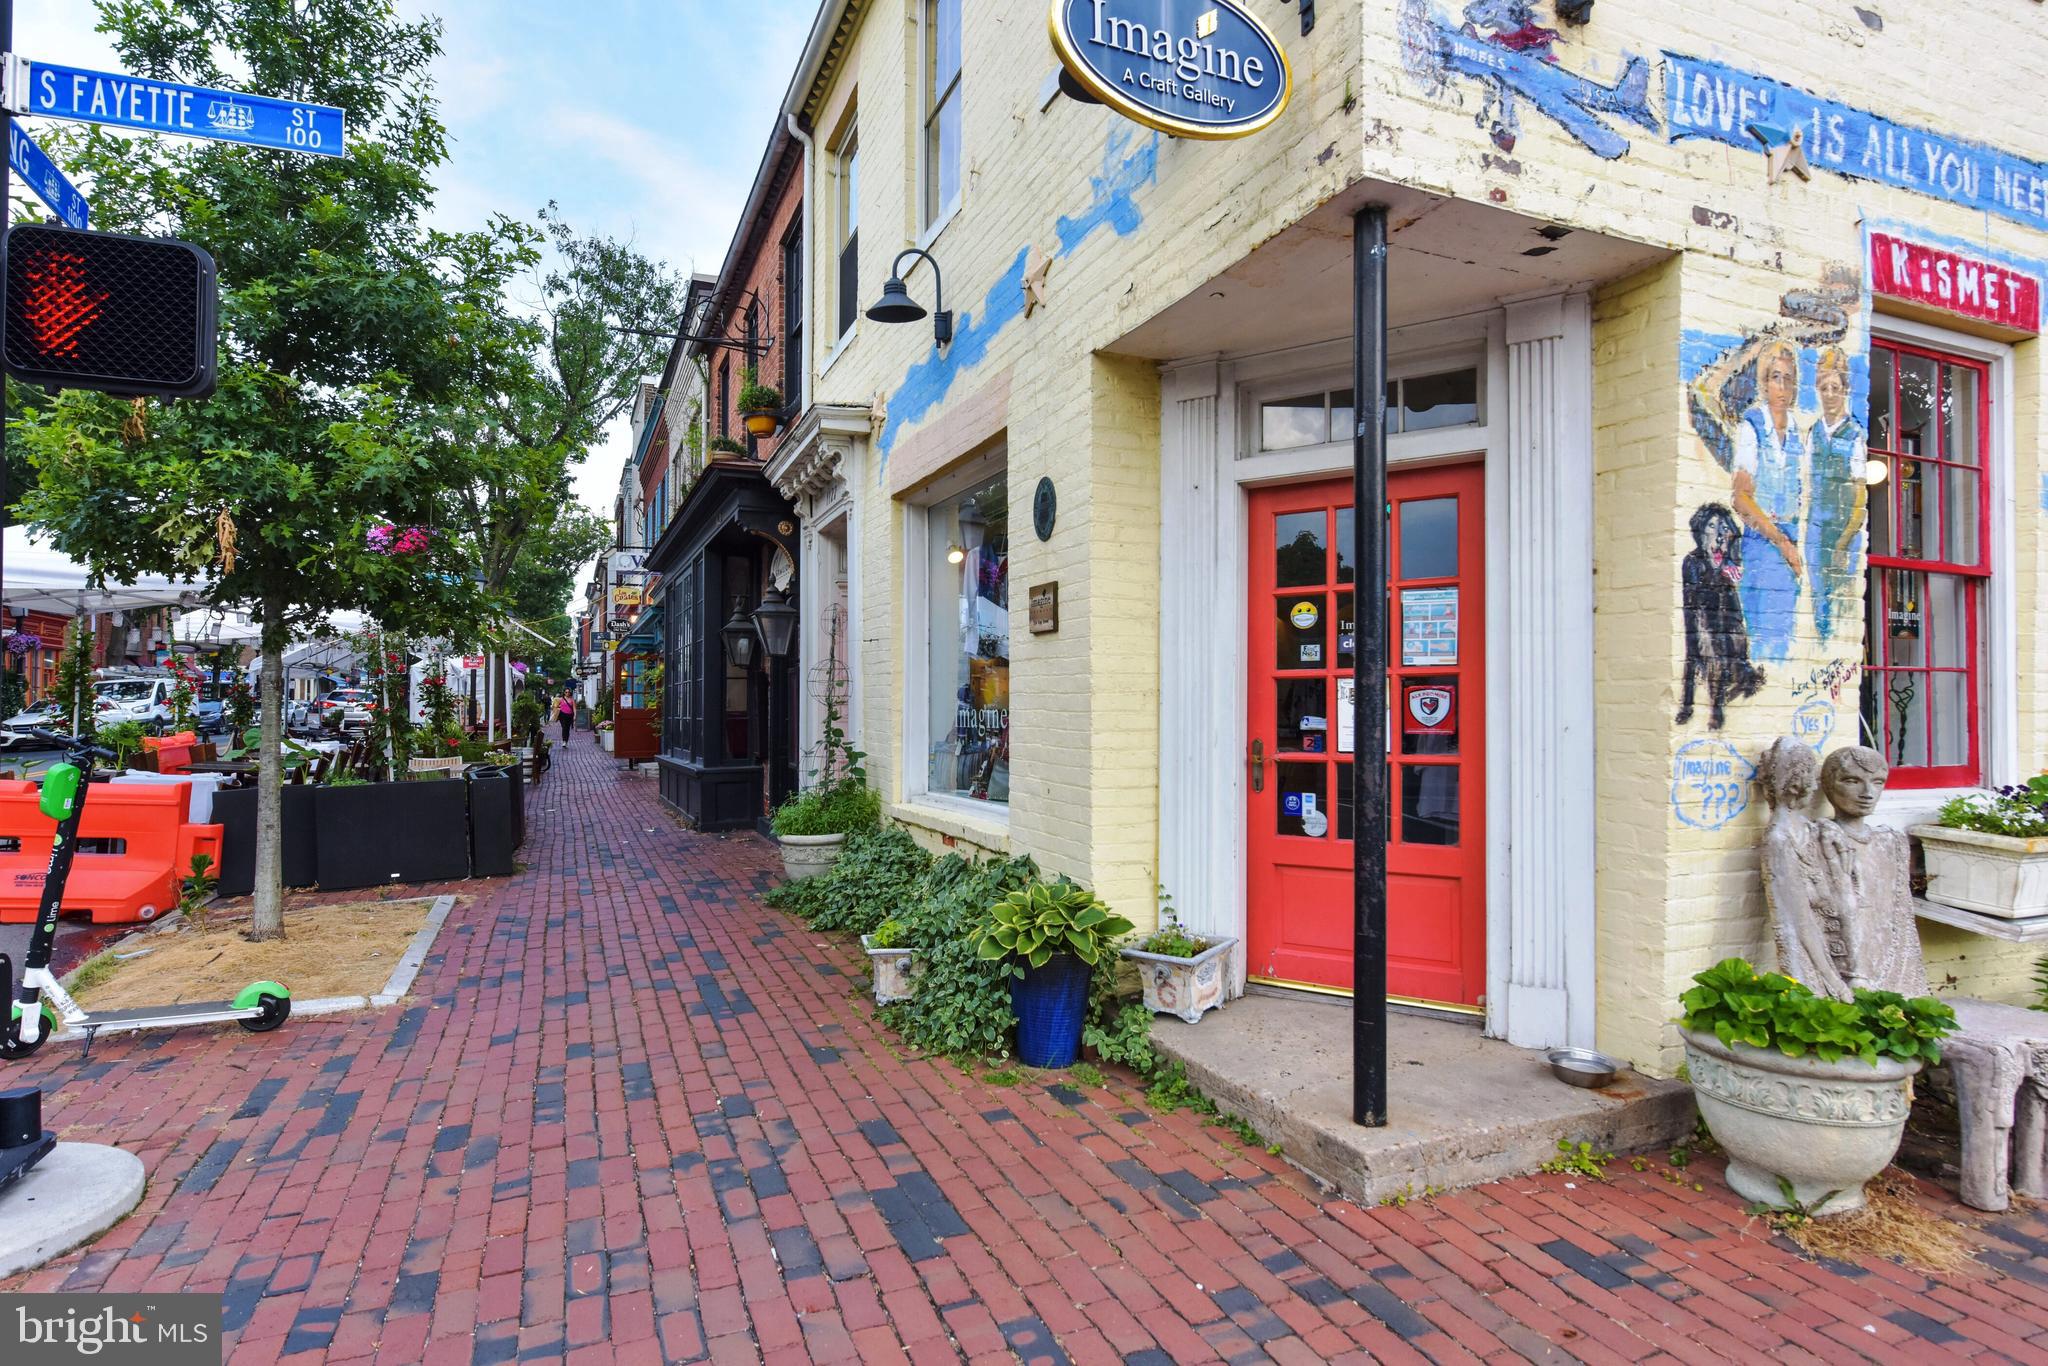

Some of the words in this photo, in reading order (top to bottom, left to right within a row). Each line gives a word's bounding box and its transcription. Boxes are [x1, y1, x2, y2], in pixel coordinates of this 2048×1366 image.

[1089, 0, 1264, 87] Imagine
[40, 70, 56, 109] S
[73, 74, 194, 128] FAYETTE
[291, 108, 317, 129] ST
[1123, 68, 1134, 84] A
[1139, 72, 1178, 95] Craft
[1182, 85, 1235, 113] Gallery
[285, 126, 321, 148] 100
[1811, 107, 1846, 164] IS
[1861, 124, 1918, 186] ALL
[1923, 141, 1980, 200] YOU
[1994, 165, 2048, 218] NEE
[72, 194, 81, 213] ST
[47, 901, 59, 922] Lime
